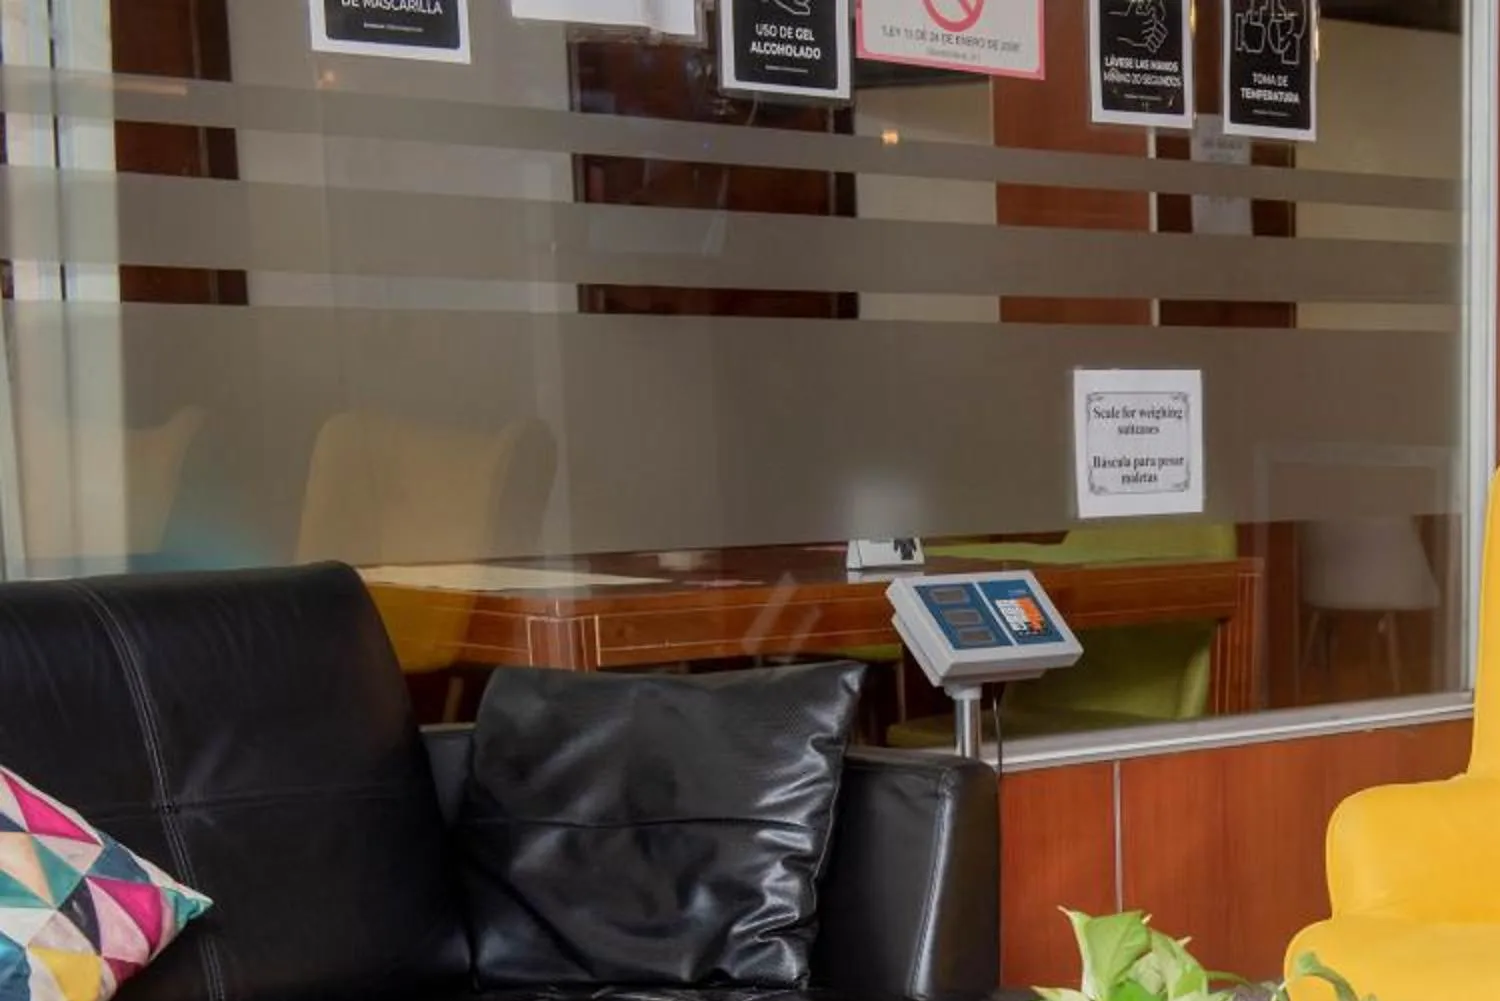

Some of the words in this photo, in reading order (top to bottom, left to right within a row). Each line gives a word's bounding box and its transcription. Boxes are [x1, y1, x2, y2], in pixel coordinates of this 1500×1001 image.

[363, 0, 443, 15] MASCARILLA
[755, 23, 778, 37] USO
[779, 25, 794, 39] DE
[795, 27, 815, 41] GEL
[750, 41, 821, 59] ALCOHOLADO
[1252, 72, 1276, 86] TOMA
[1277, 74, 1289, 87] DE
[1240, 87, 1300, 104] TEMPERATURA
[1093, 405, 1120, 420] Scale
[1121, 406, 1136, 419] for
[1139, 404, 1183, 420] weighing
[1133, 457, 1155, 470] para
[1157, 456, 1184, 470] pesar
[1121, 471, 1158, 484] maletas
